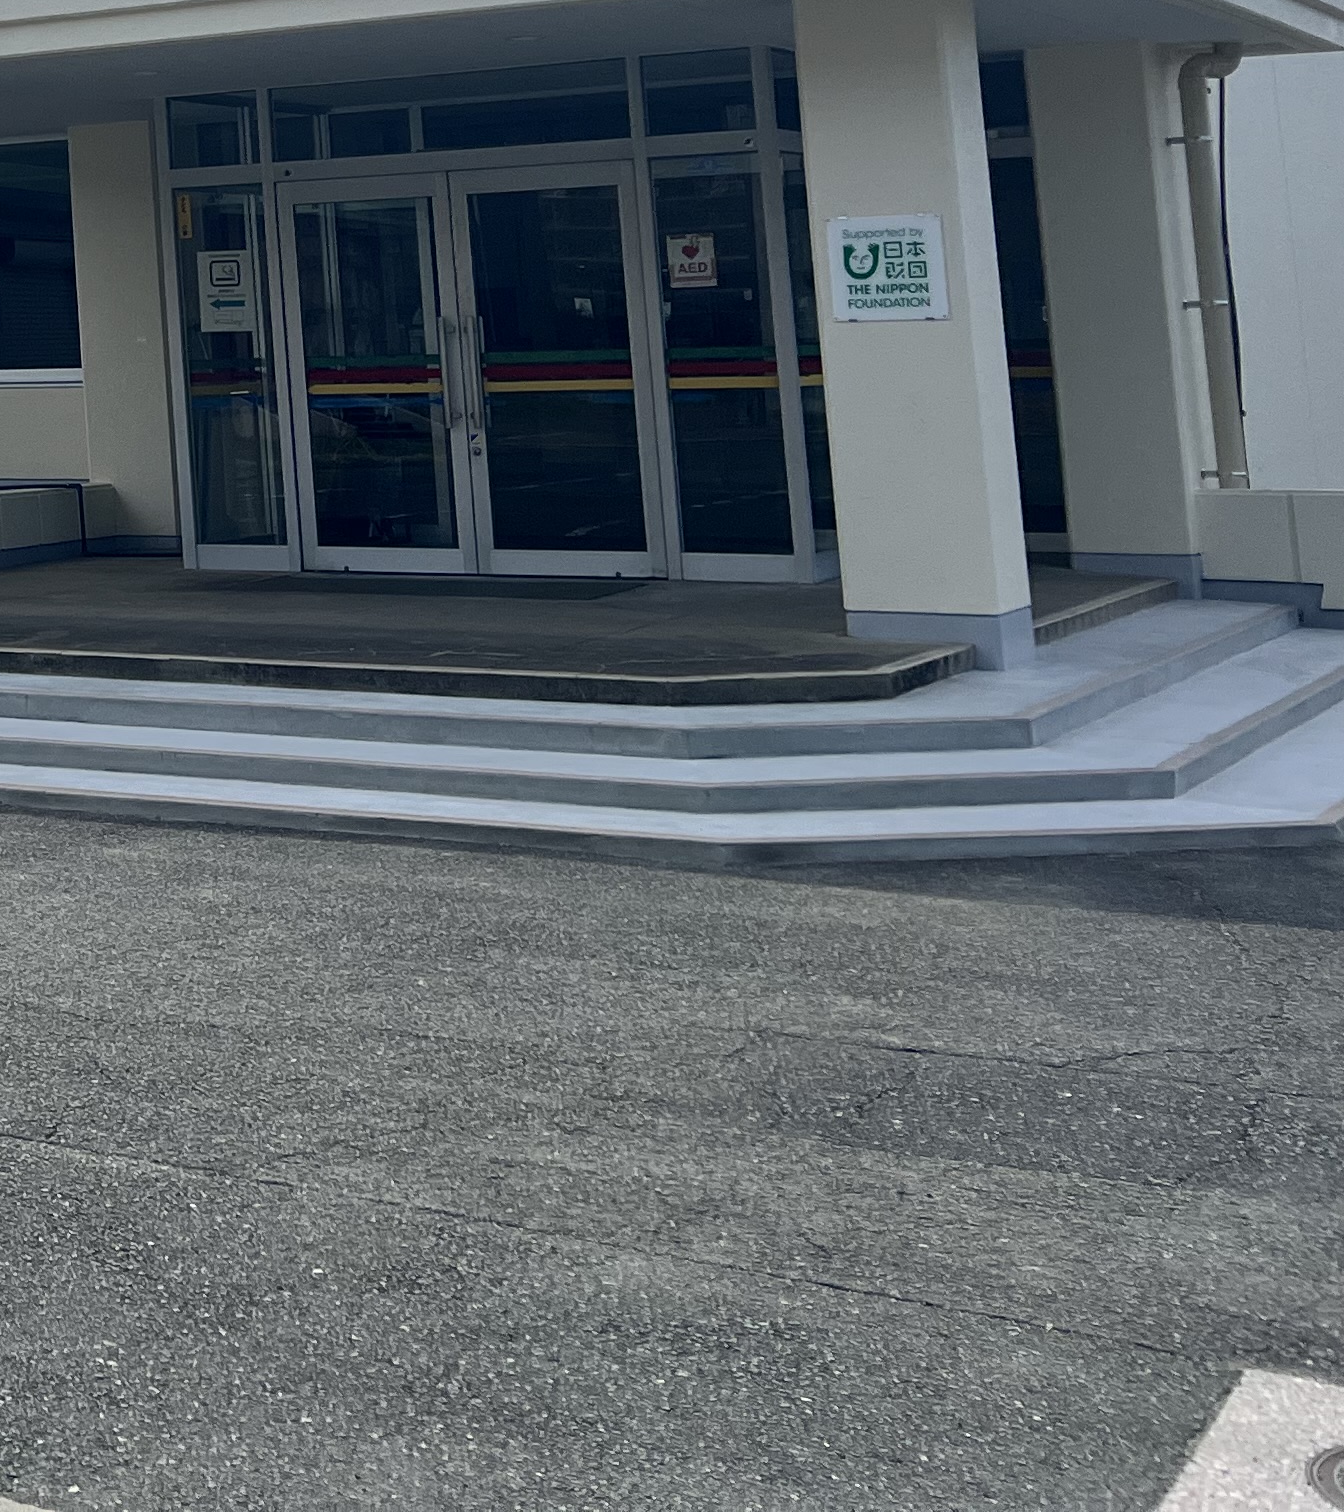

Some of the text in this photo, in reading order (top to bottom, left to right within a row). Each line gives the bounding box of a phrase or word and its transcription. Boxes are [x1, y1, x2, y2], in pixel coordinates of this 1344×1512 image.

[842, 227, 923, 240] Supported by
[883, 241, 926, 258] 日本
[678, 262, 708, 274] AED
[885, 261, 928, 279] 財団
[847, 282, 930, 295] THE NIPPON
[848, 297, 931, 309] FOUNDATION
